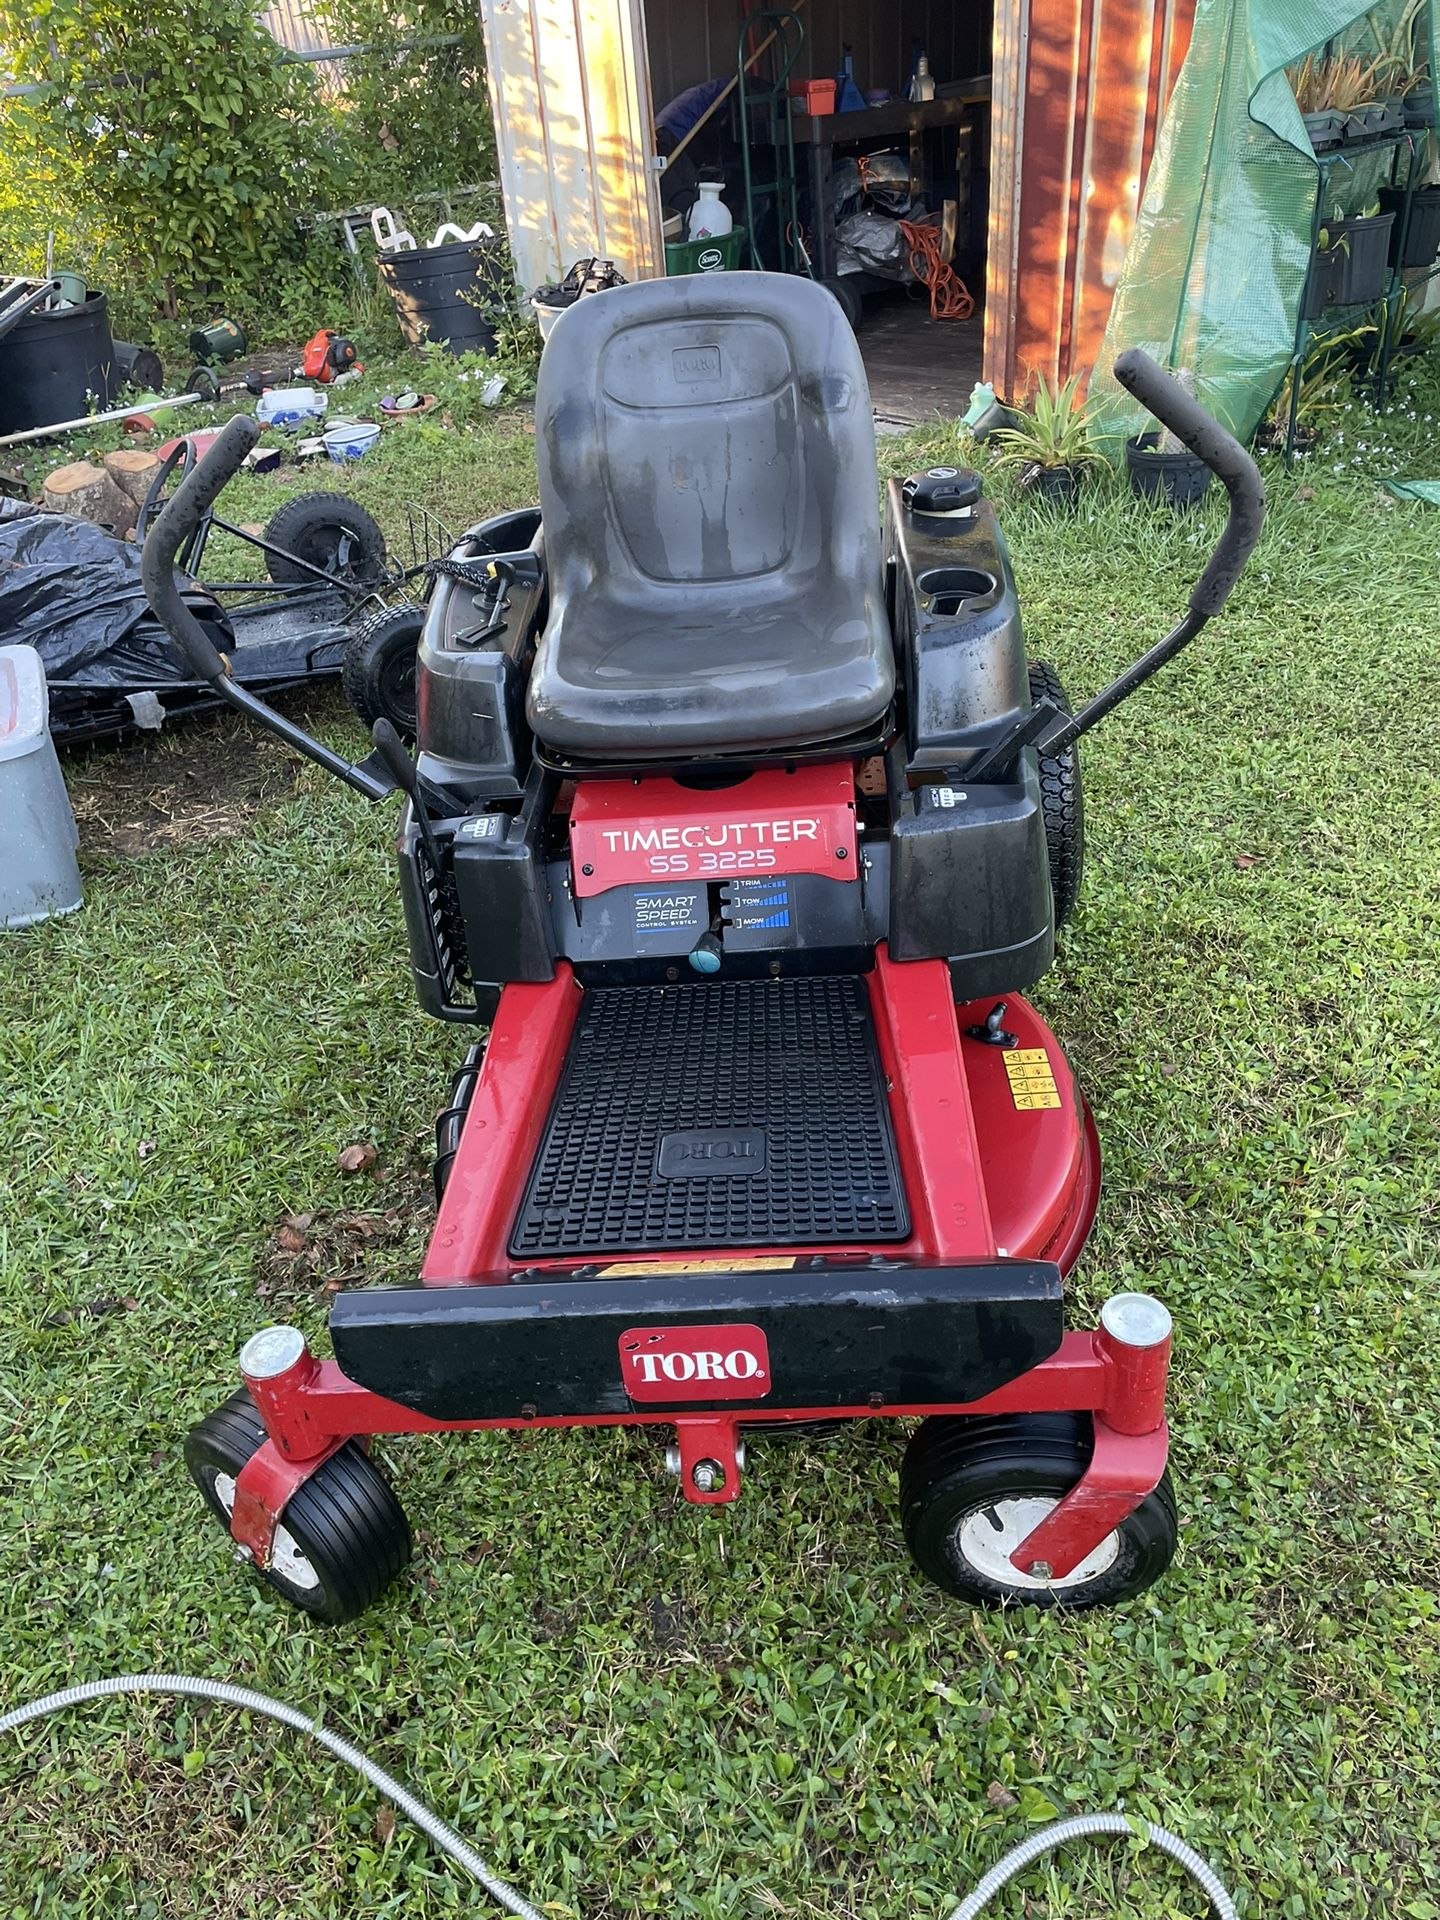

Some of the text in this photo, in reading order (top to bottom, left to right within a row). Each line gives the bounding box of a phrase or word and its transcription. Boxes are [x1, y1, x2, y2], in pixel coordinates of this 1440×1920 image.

[602, 819, 817, 852] TIMECUTTER
[650, 849, 776, 874] SS 3225
[635, 896, 697, 910] SMART
[636, 909, 692, 922] SPEED
[743, 917, 765, 925] MOW
[632, 1350, 758, 1382] TORO
